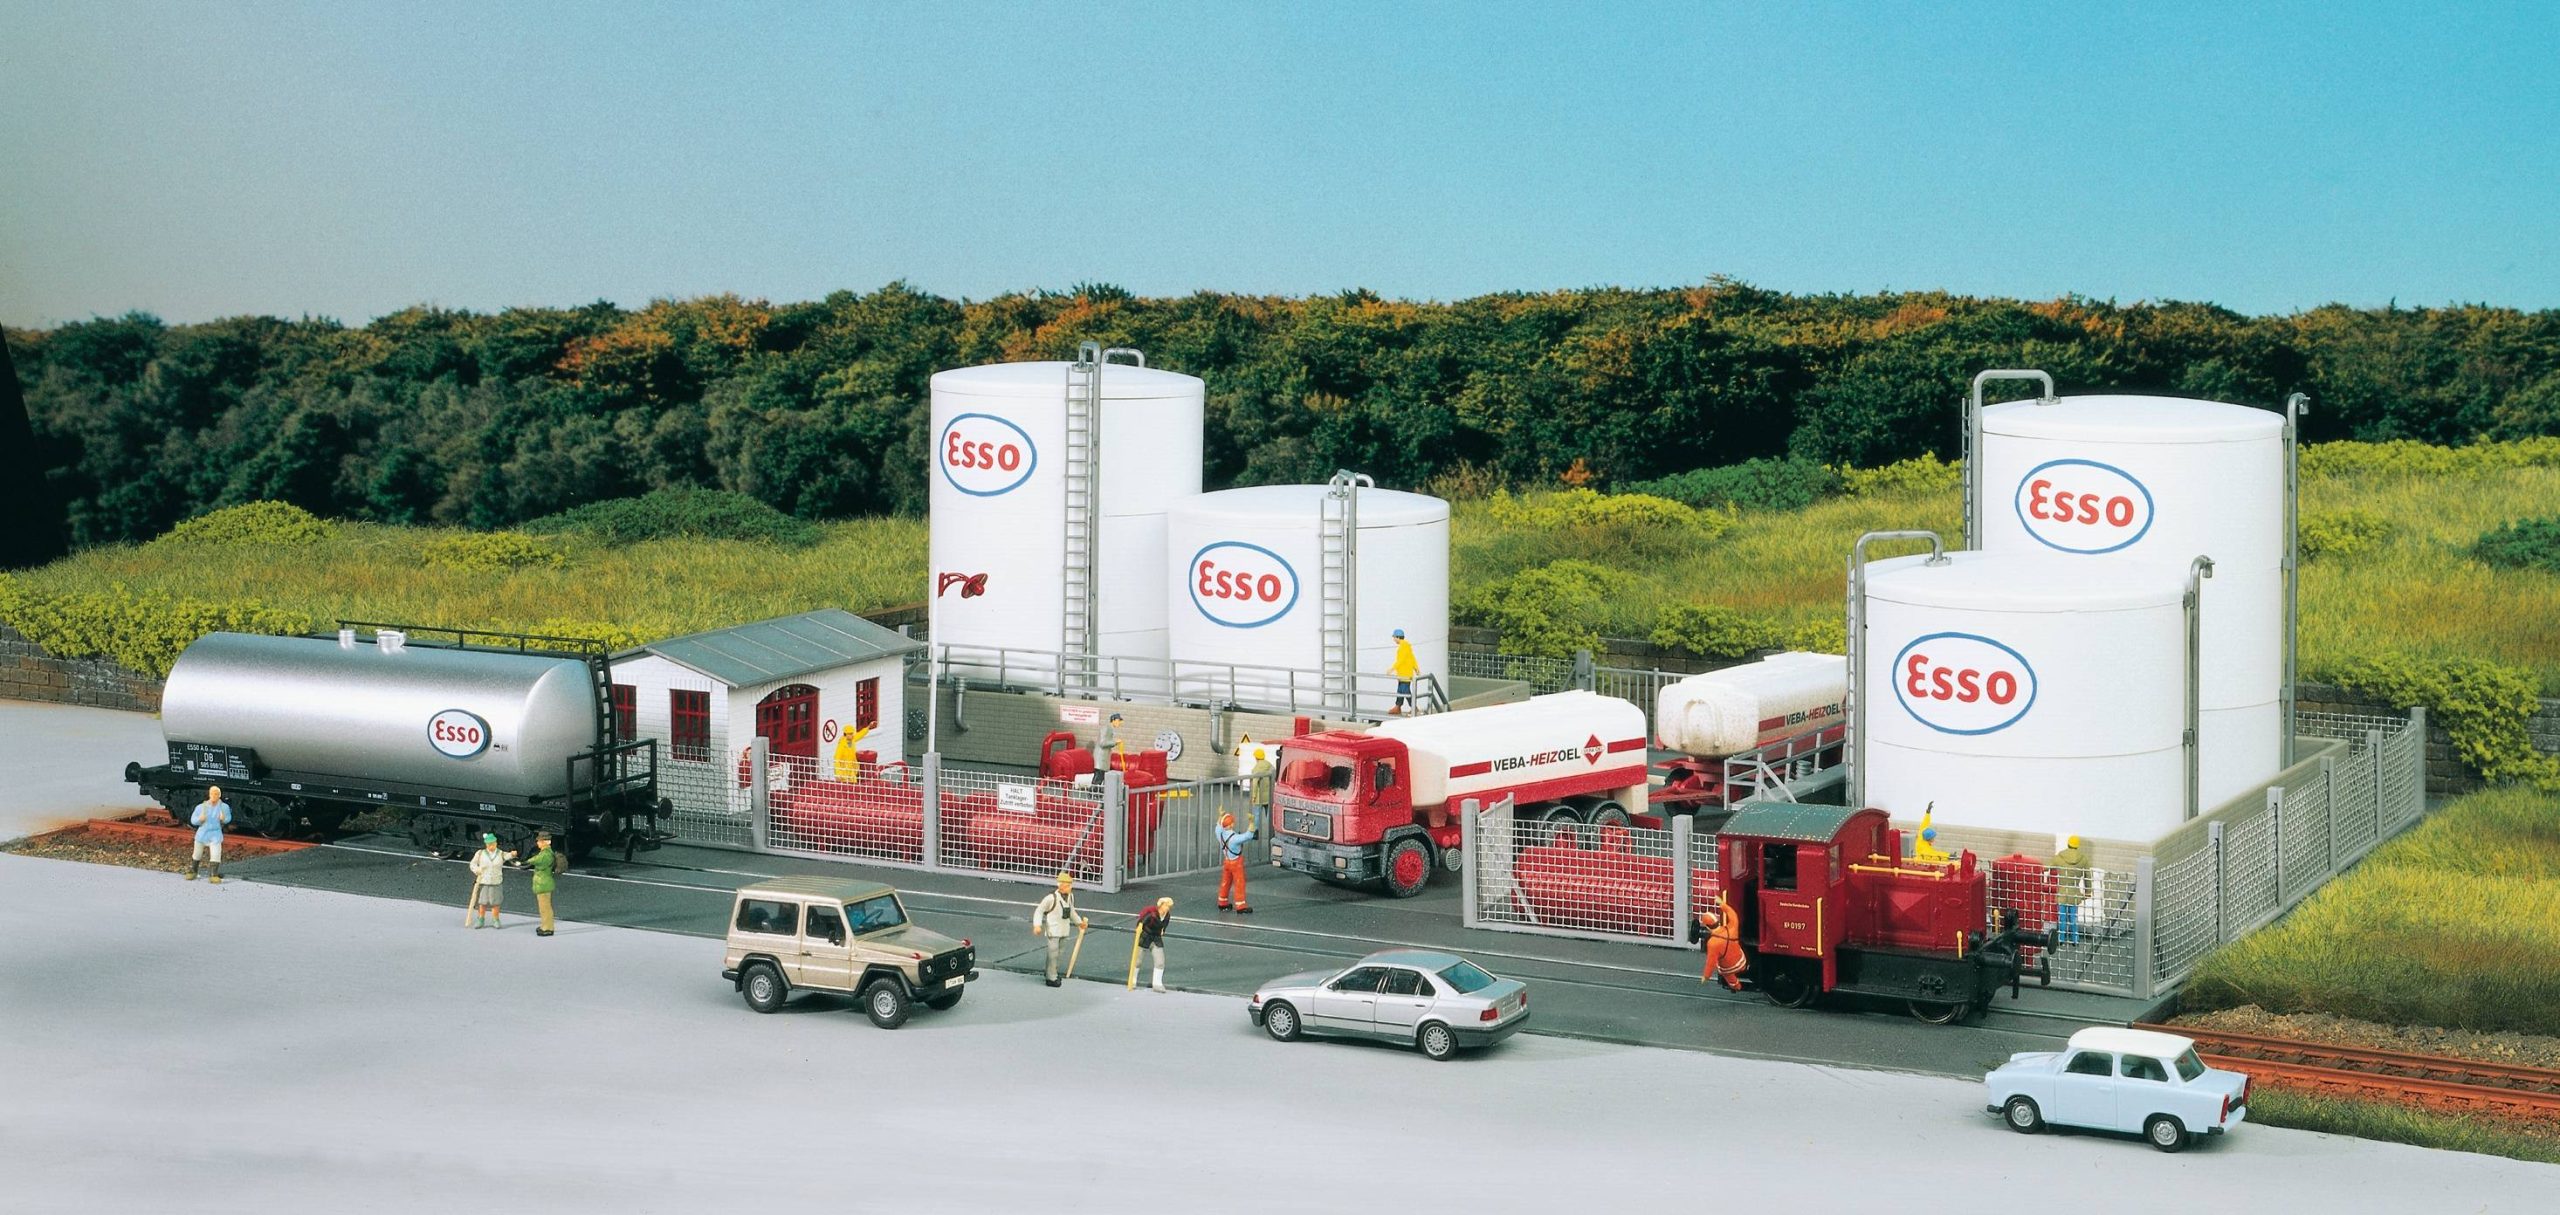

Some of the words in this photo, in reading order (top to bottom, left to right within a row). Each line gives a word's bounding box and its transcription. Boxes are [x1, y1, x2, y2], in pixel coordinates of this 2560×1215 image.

[948, 431, 1020, 471] Esso
[2029, 479, 2134, 527] Esso
[1199, 560, 1282, 602] Esso
[1907, 653, 2017, 704] Esso
[436, 720, 479, 743] Esso
[1786, 703, 1840, 725] VEBA-HEIZOEL
[1494, 748, 1581, 771] VEBA-HEIZOEL
